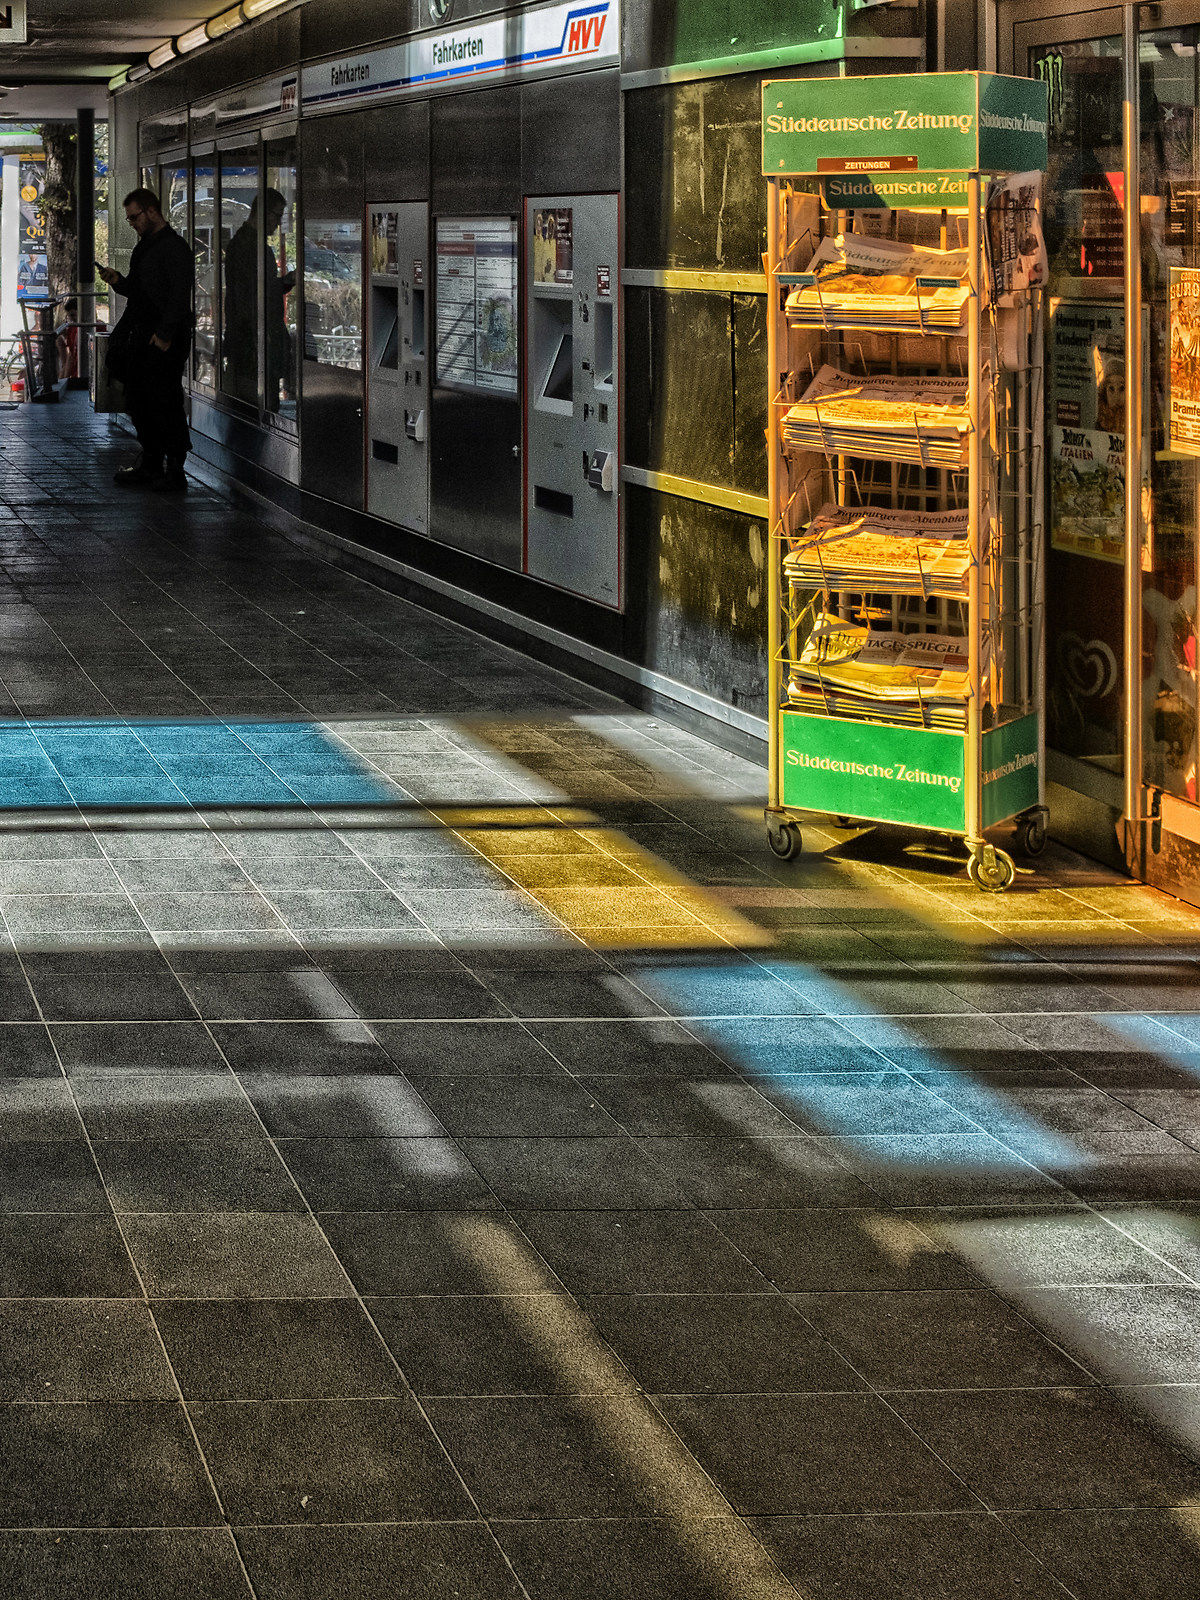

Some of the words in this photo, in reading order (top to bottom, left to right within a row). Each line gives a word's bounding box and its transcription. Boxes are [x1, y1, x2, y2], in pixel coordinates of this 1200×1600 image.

[568, 15, 607, 52] HVV
[432, 37, 484, 65] Fahrkarten
[331, 63, 370, 86] Fahrkarten
[766, 114, 893, 133] Süddeutsche
[894, 110, 974, 134] Zeitung
[980, 109, 1023, 132] Süddeutsche
[1022, 113, 1047, 139] Zeitung
[844, 161, 891, 170] ZEITUNGEN
[829, 180, 938, 196] Süddeutsche
[1060, 446, 1094, 461] ITALIEN
[786, 750, 894, 780] Süddeutsche
[894, 763, 962, 793] Zeitung
